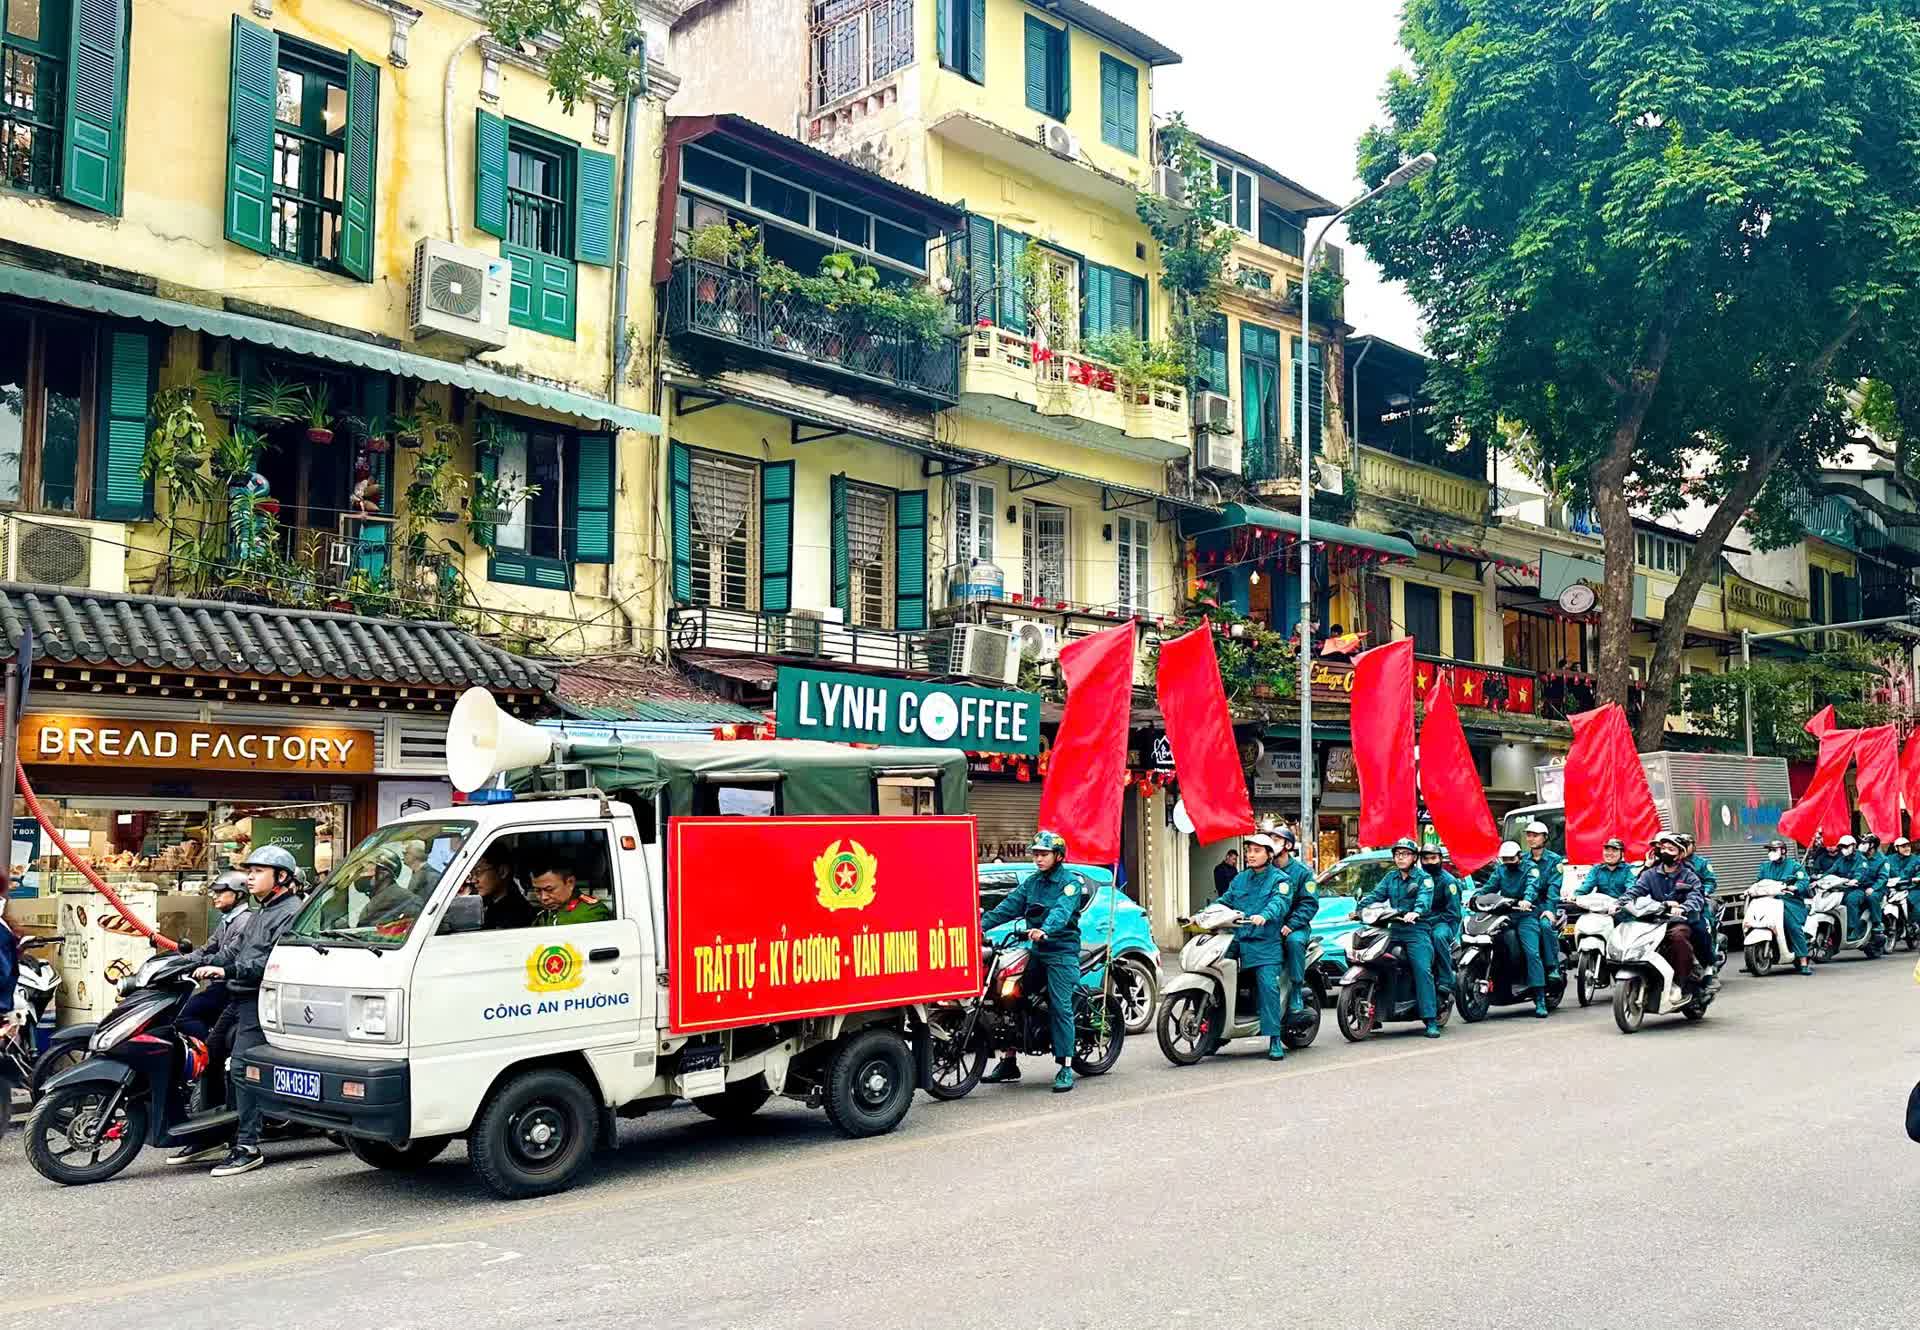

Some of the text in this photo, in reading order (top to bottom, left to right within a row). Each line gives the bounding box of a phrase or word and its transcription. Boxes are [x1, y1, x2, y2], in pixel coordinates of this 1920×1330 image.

[800, 680, 887, 732] LYNH
[40, 727, 353, 762] BREAD FACTORY
[997, 843, 1026, 857] ANH
[694, 934, 733, 1003] TRẬT
[736, 937, 757, 1000] TỰ
[770, 924, 788, 986] KỶ
[793, 933, 840, 984] CƯƠNG
[853, 923, 880, 978] VĂN
[883, 929, 918, 974] MINH
[929, 918, 945, 970] ĐÔ
[948, 927, 968, 976] THỊ
[484, 992, 629, 1020] CÔNG AN PHƯỜNG
